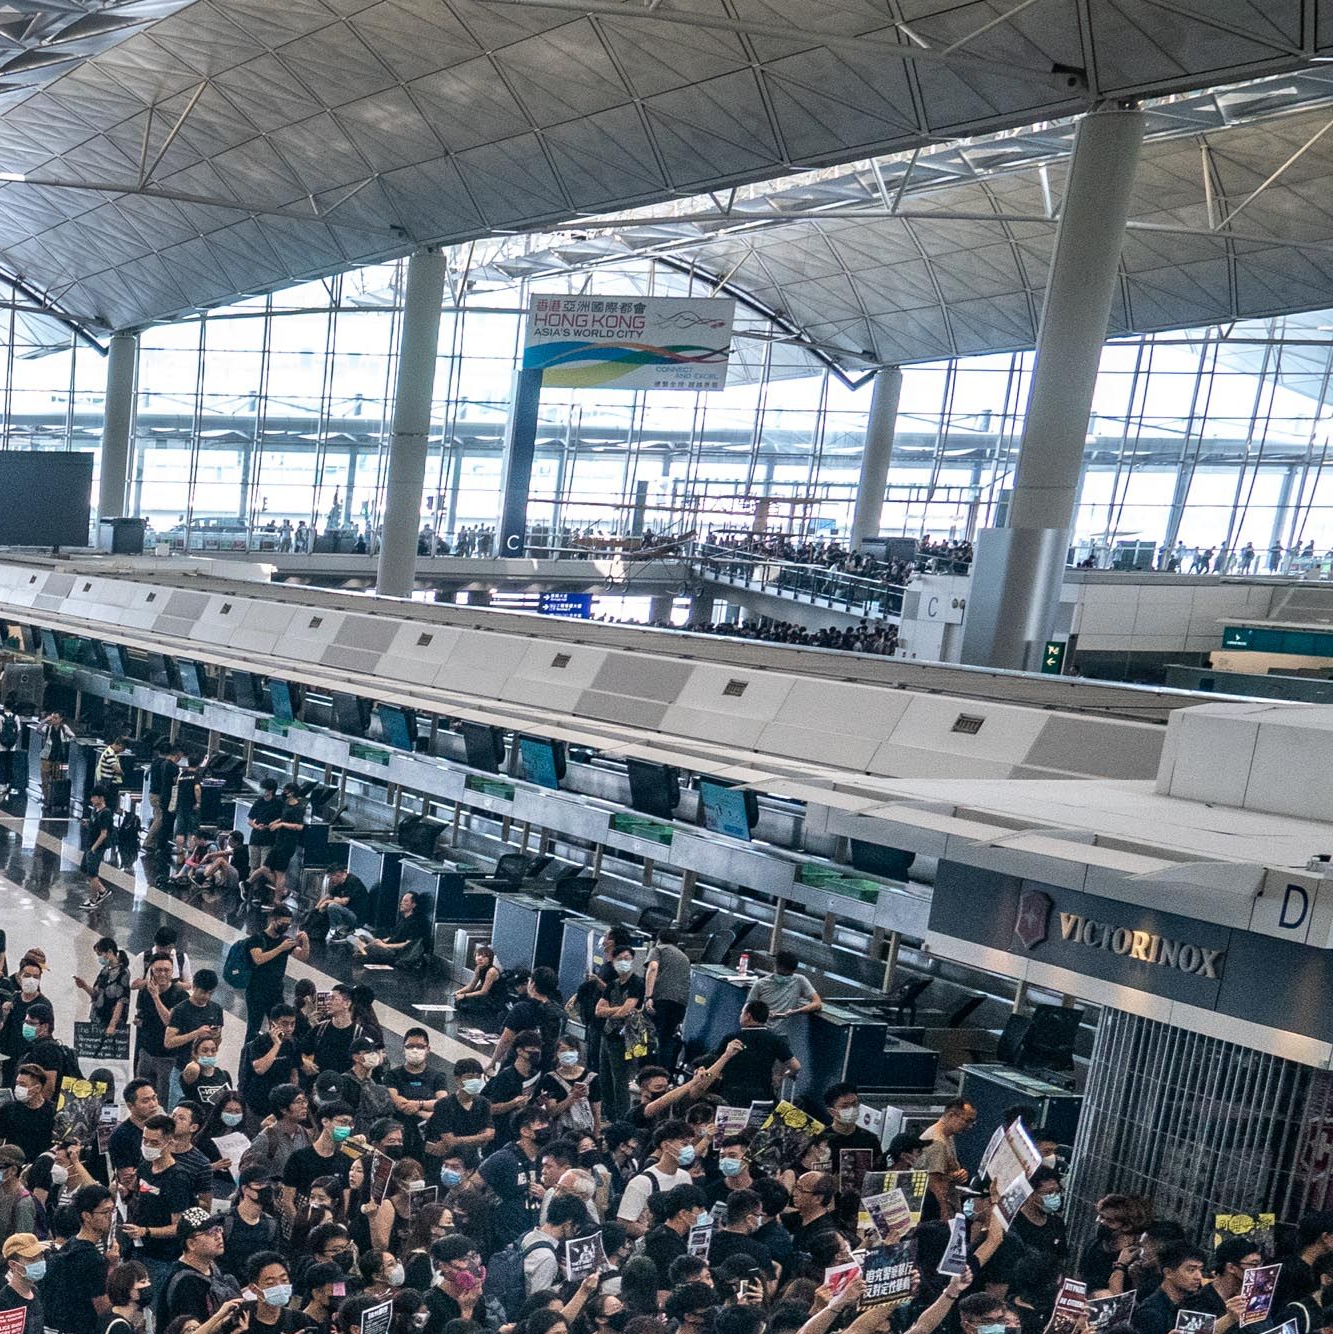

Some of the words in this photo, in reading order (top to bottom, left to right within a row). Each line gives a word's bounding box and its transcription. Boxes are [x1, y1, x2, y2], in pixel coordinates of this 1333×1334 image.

[536, 299, 646, 314] 香港亞洲國際都會
[534, 313, 590, 327] HONG
[592, 314, 646, 329] KONG
[534, 328, 571, 337] ASIA'S
[573, 328, 613, 338] WORLD
[614, 329, 643, 339] CITY
[506, 534, 519, 550] C
[927, 597, 939, 618] C
[1278, 884, 1309, 930] D
[1059, 911, 1223, 980] VICTORINOX
